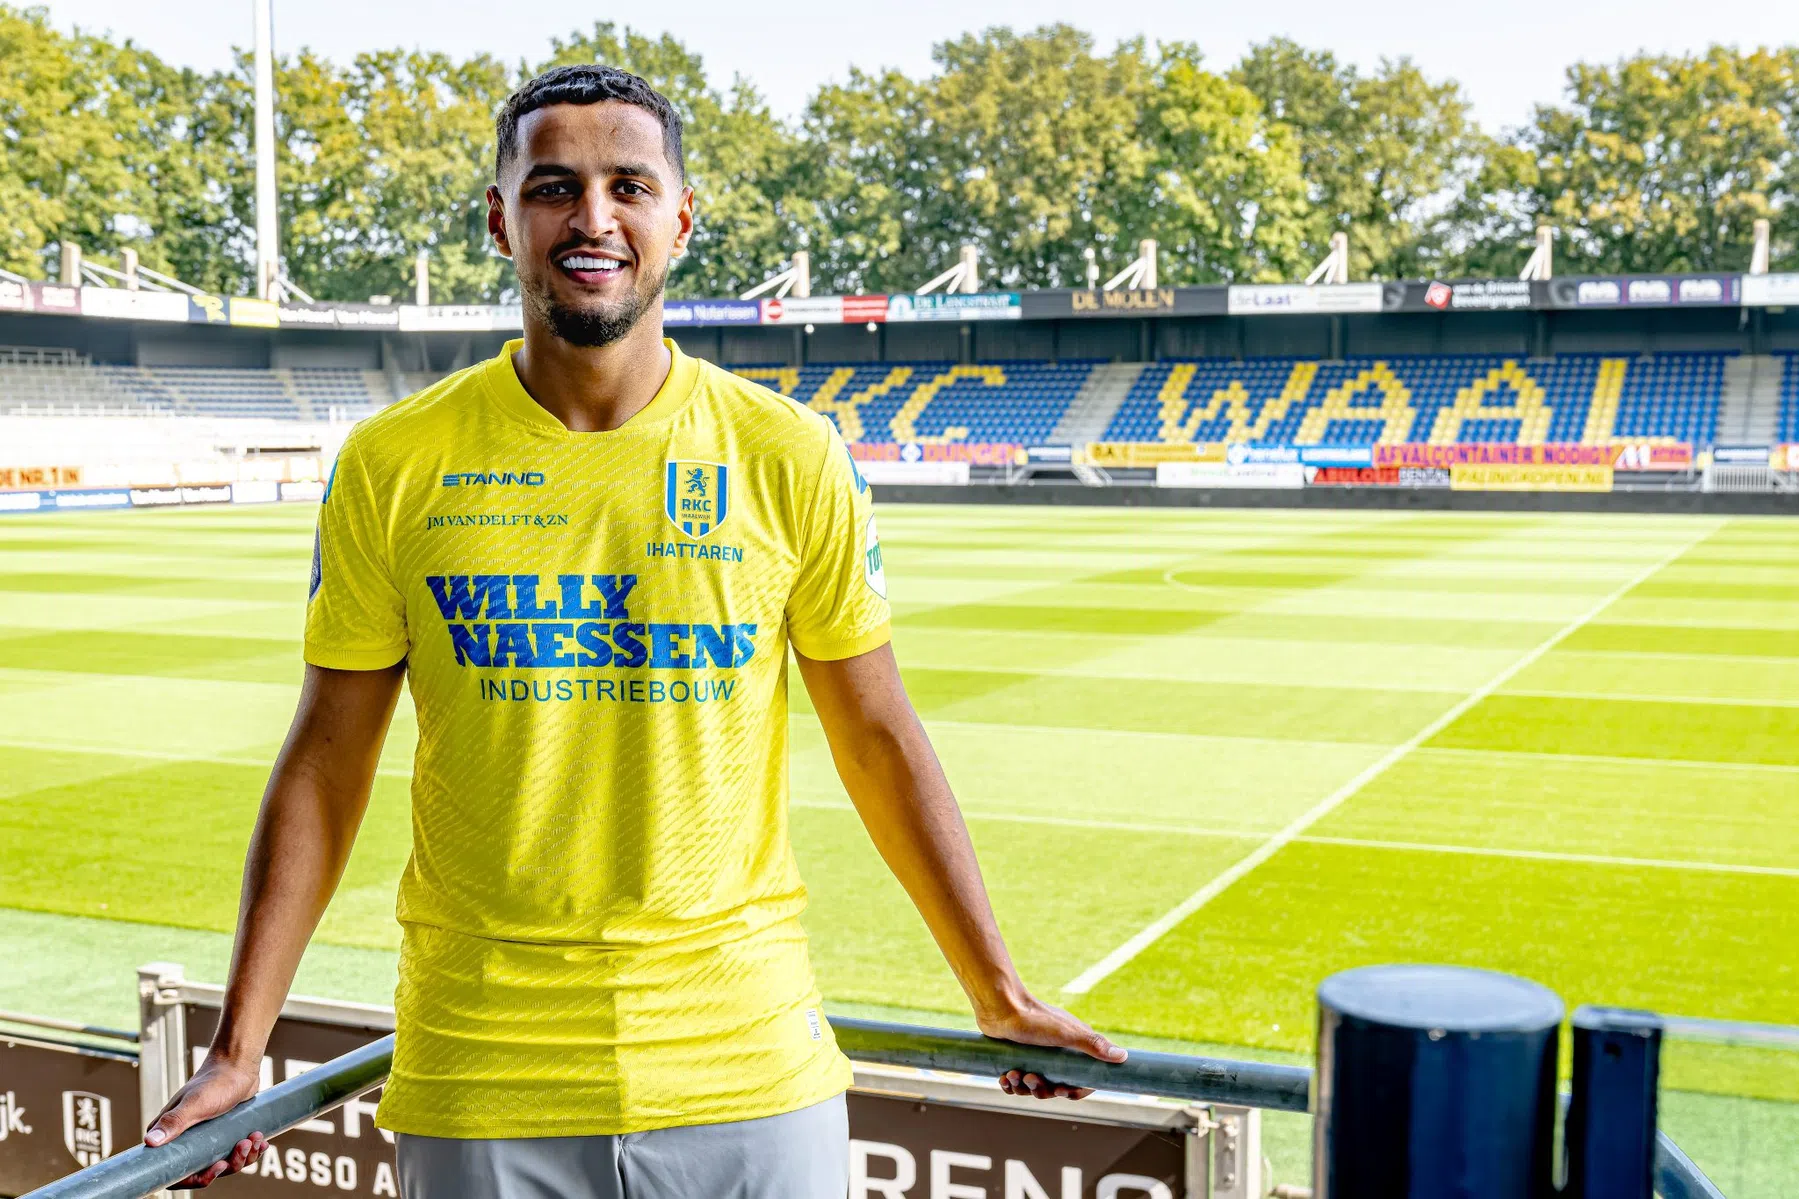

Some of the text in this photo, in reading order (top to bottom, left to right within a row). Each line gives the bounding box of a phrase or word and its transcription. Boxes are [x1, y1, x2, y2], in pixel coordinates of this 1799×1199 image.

[1103, 289, 1174, 309] MOLEN
[443, 472, 546, 487] STANNO
[682, 499, 711, 512] RKC
[447, 515, 476, 526] VAN
[647, 542, 743, 562] IHATTAREN
[426, 574, 638, 620] WILLY
[448, 622, 757, 669] NAESSENS
[481, 678, 735, 703] INDUSTRIEBOUW
[240, 1145, 358, 1191] ASSO
